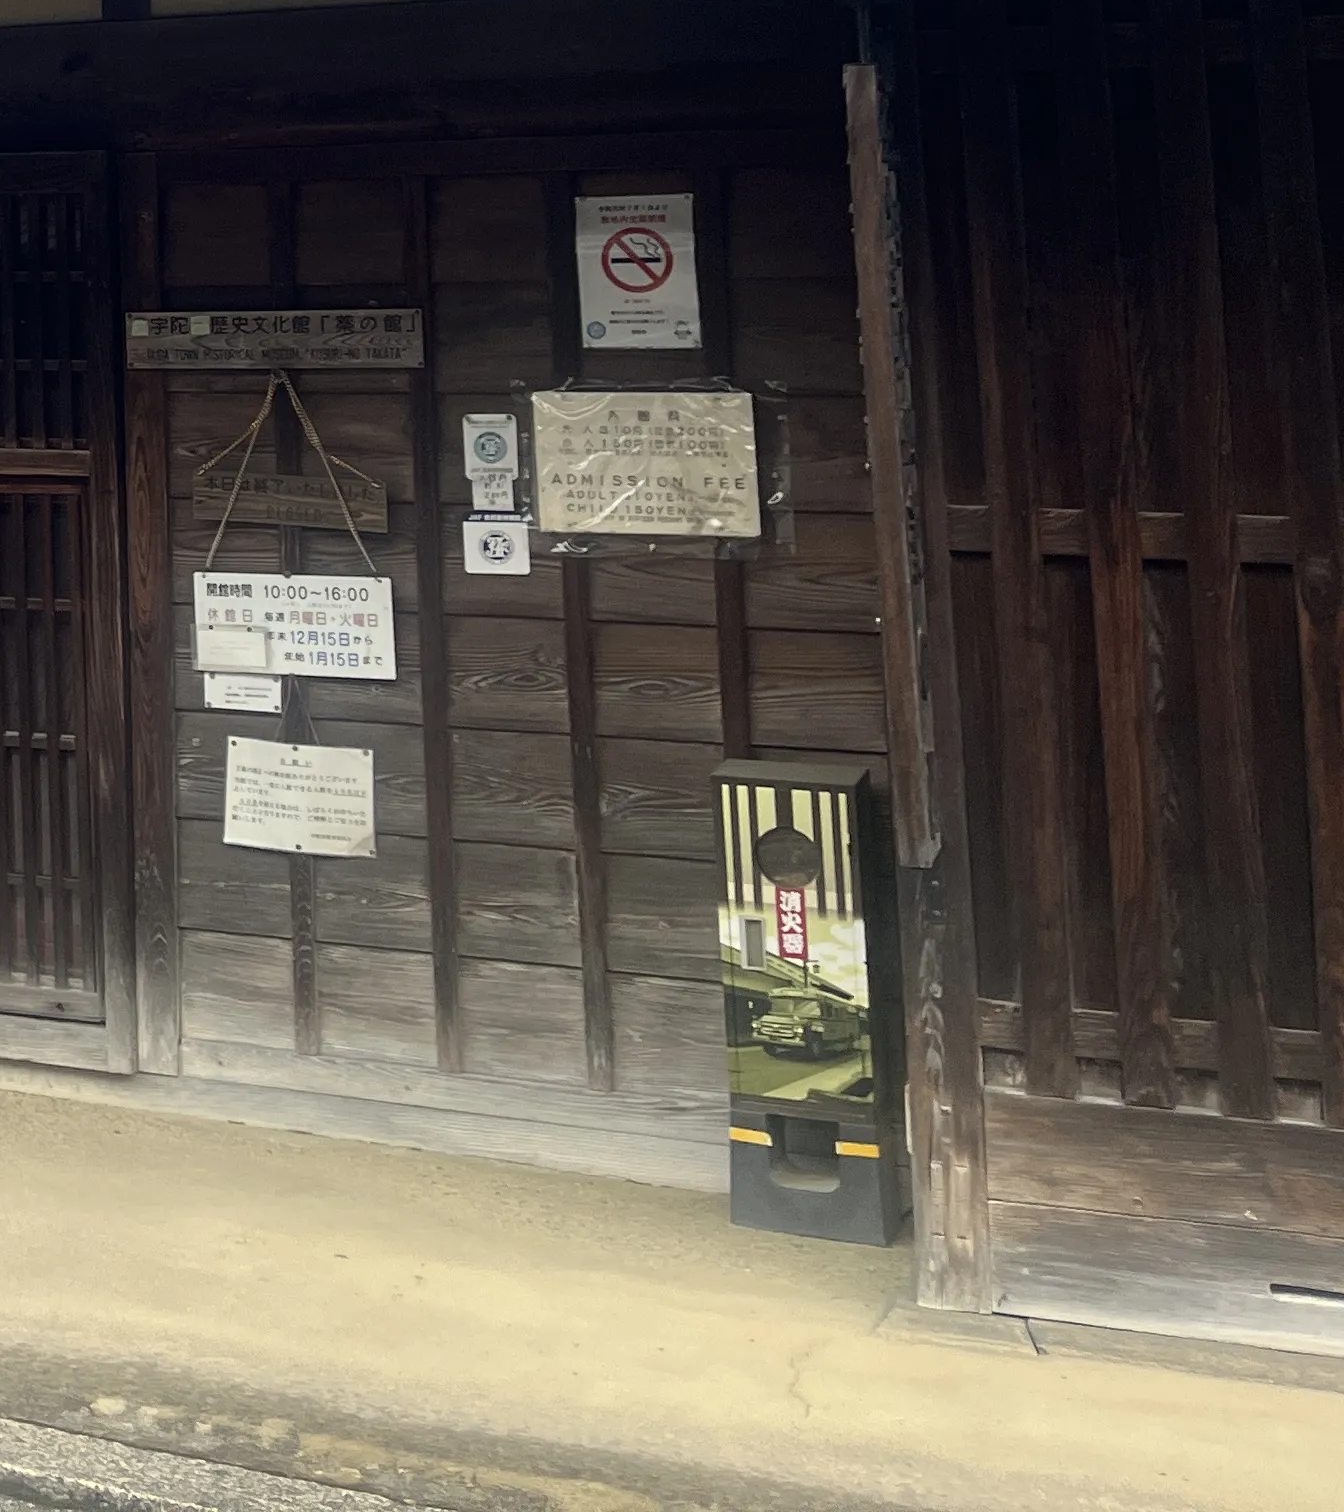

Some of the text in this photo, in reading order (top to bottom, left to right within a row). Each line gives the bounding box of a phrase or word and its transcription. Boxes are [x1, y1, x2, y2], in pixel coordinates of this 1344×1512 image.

[551, 473, 746, 490] ADMISSION FEE
[206, 583, 253, 598] 開館時間
[208, 608, 253, 623] 休館日
